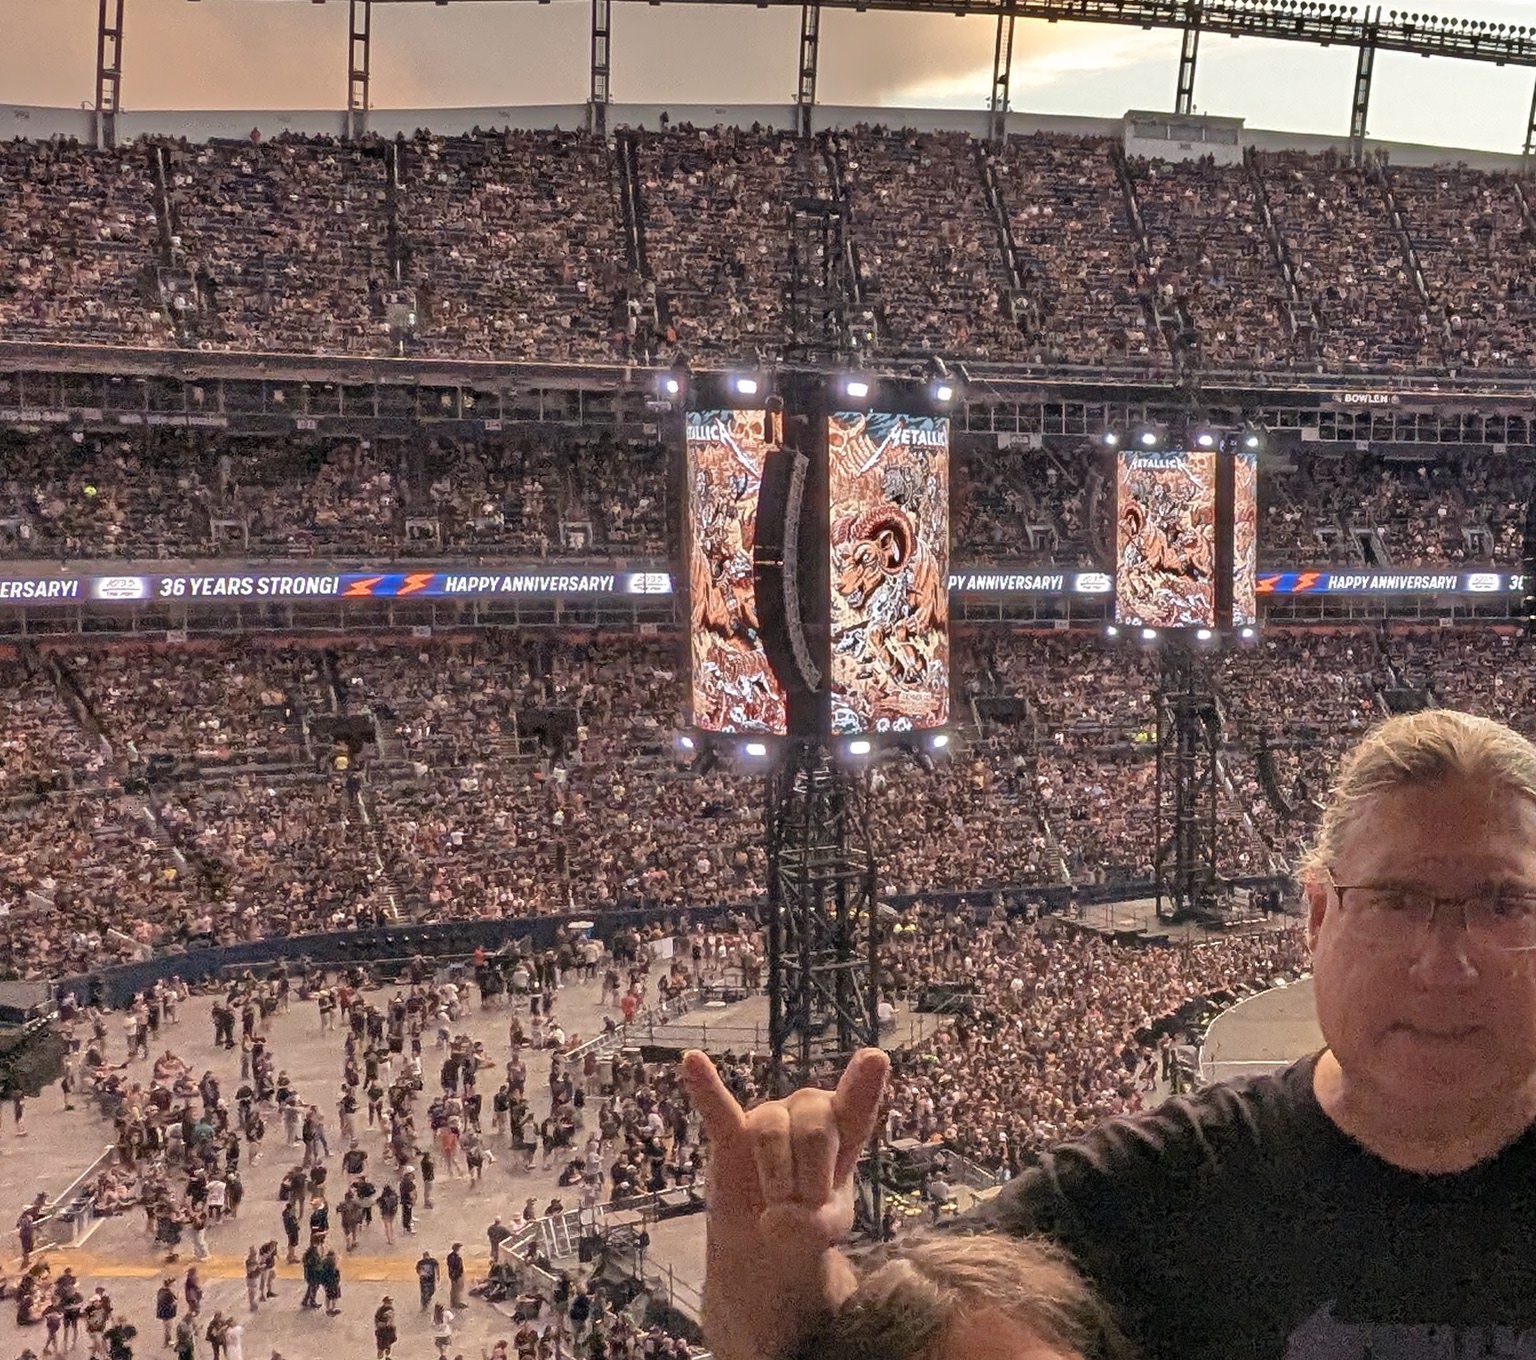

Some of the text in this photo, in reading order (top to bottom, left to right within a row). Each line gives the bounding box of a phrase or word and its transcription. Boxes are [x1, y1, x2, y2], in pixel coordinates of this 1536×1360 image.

[1344, 393, 1389, 403] BOWLEN
[0, 580, 78, 598] ERSARY!
[160, 576, 340, 596] 36 YEARS STRONG!
[445, 575, 615, 592] HAPPY ANNIVERSARY!
[966, 575, 1064, 590] ANNIVERSARY!
[1327, 575, 1370, 590] HAPPY
[1369, 575, 1458, 590] ANNIVERSARY!
